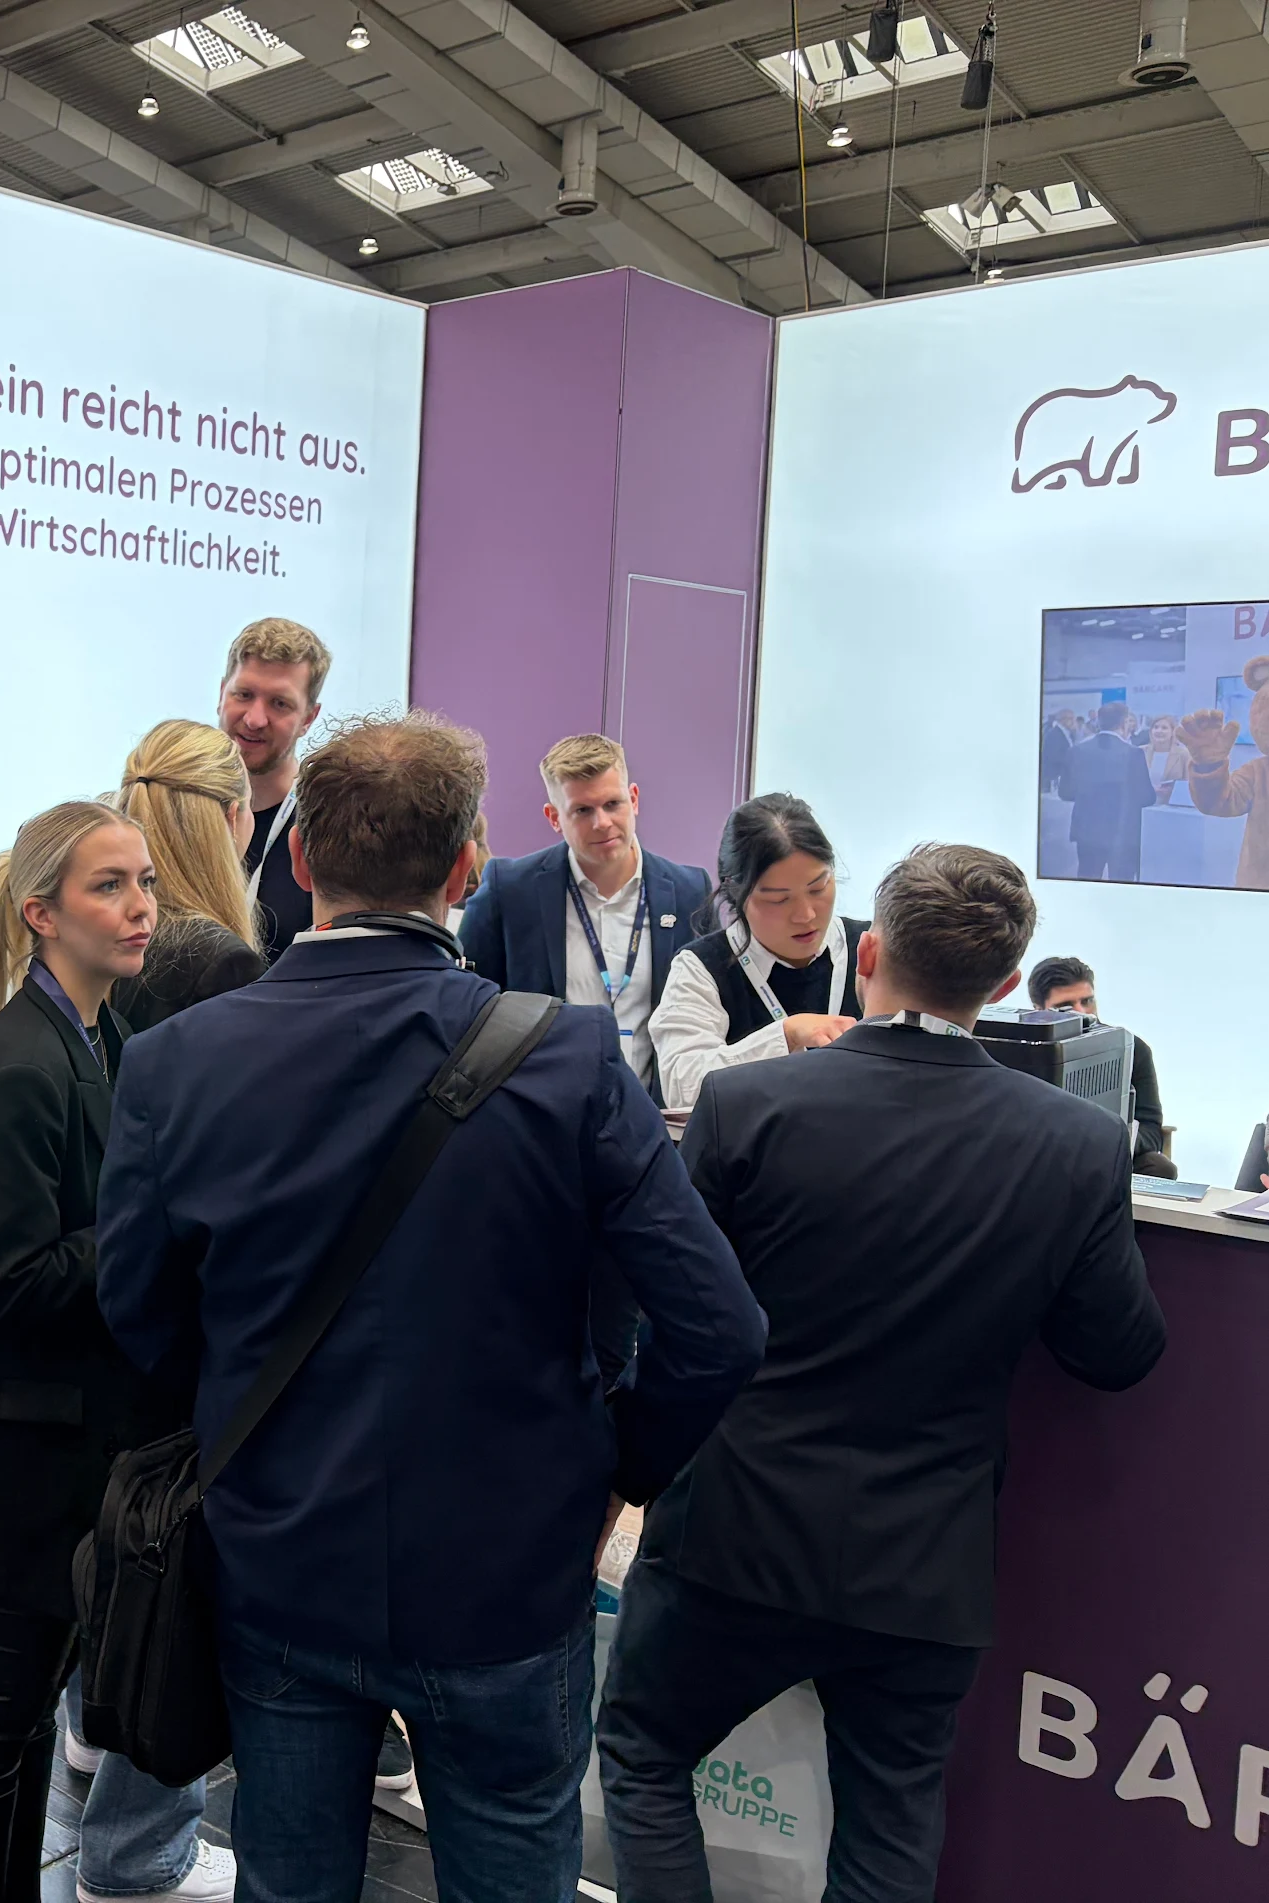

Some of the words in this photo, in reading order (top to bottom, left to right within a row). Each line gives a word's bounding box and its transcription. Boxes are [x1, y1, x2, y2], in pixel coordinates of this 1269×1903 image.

[62, 384, 182, 443] reicht
[197, 405, 287, 460] nicht
[299, 434, 367, 476] aus.
[1214, 408, 1269, 477] B
[170, 468, 322, 524] Prozessen
[1234, 605, 1269, 640] B
